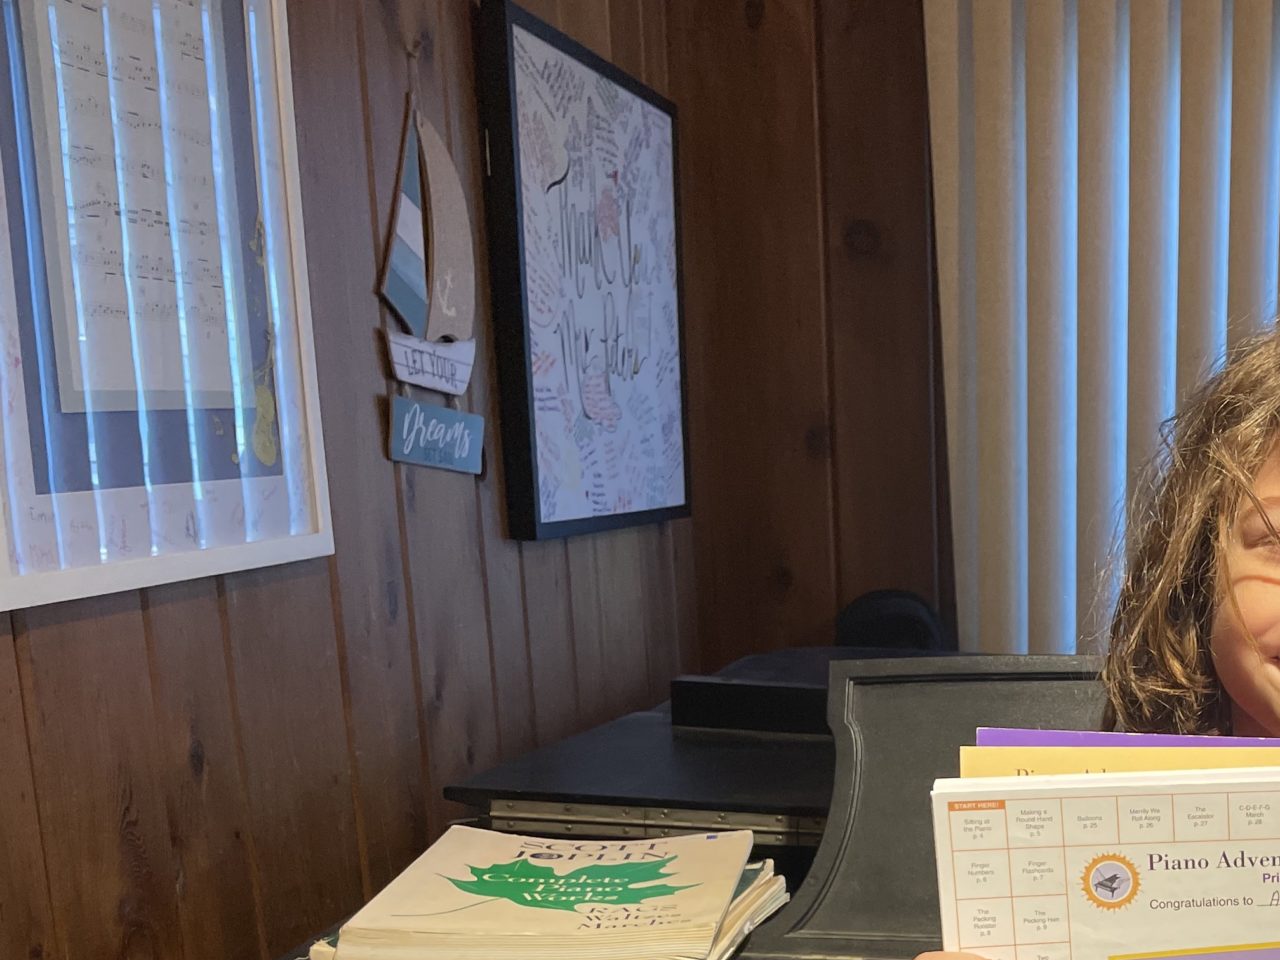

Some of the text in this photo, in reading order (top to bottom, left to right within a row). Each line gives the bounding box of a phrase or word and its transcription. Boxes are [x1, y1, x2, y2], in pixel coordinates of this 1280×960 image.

[404, 349, 458, 390] LET YOUR
[402, 403, 472, 460] Dreams
[520, 840, 669, 852] SCOTT
[514, 850, 669, 861] JOPLIN
[1147, 852, 1209, 871] Piano
[482, 872, 630, 885] Complete
[535, 883, 624, 892] Piano
[522, 892, 620, 901] Works
[589, 903, 679, 914] RAGS
[1149, 896, 1254, 911] Congratulations to
[586, 913, 682, 921] Waltzes
[577, 918, 692, 930] Marches
